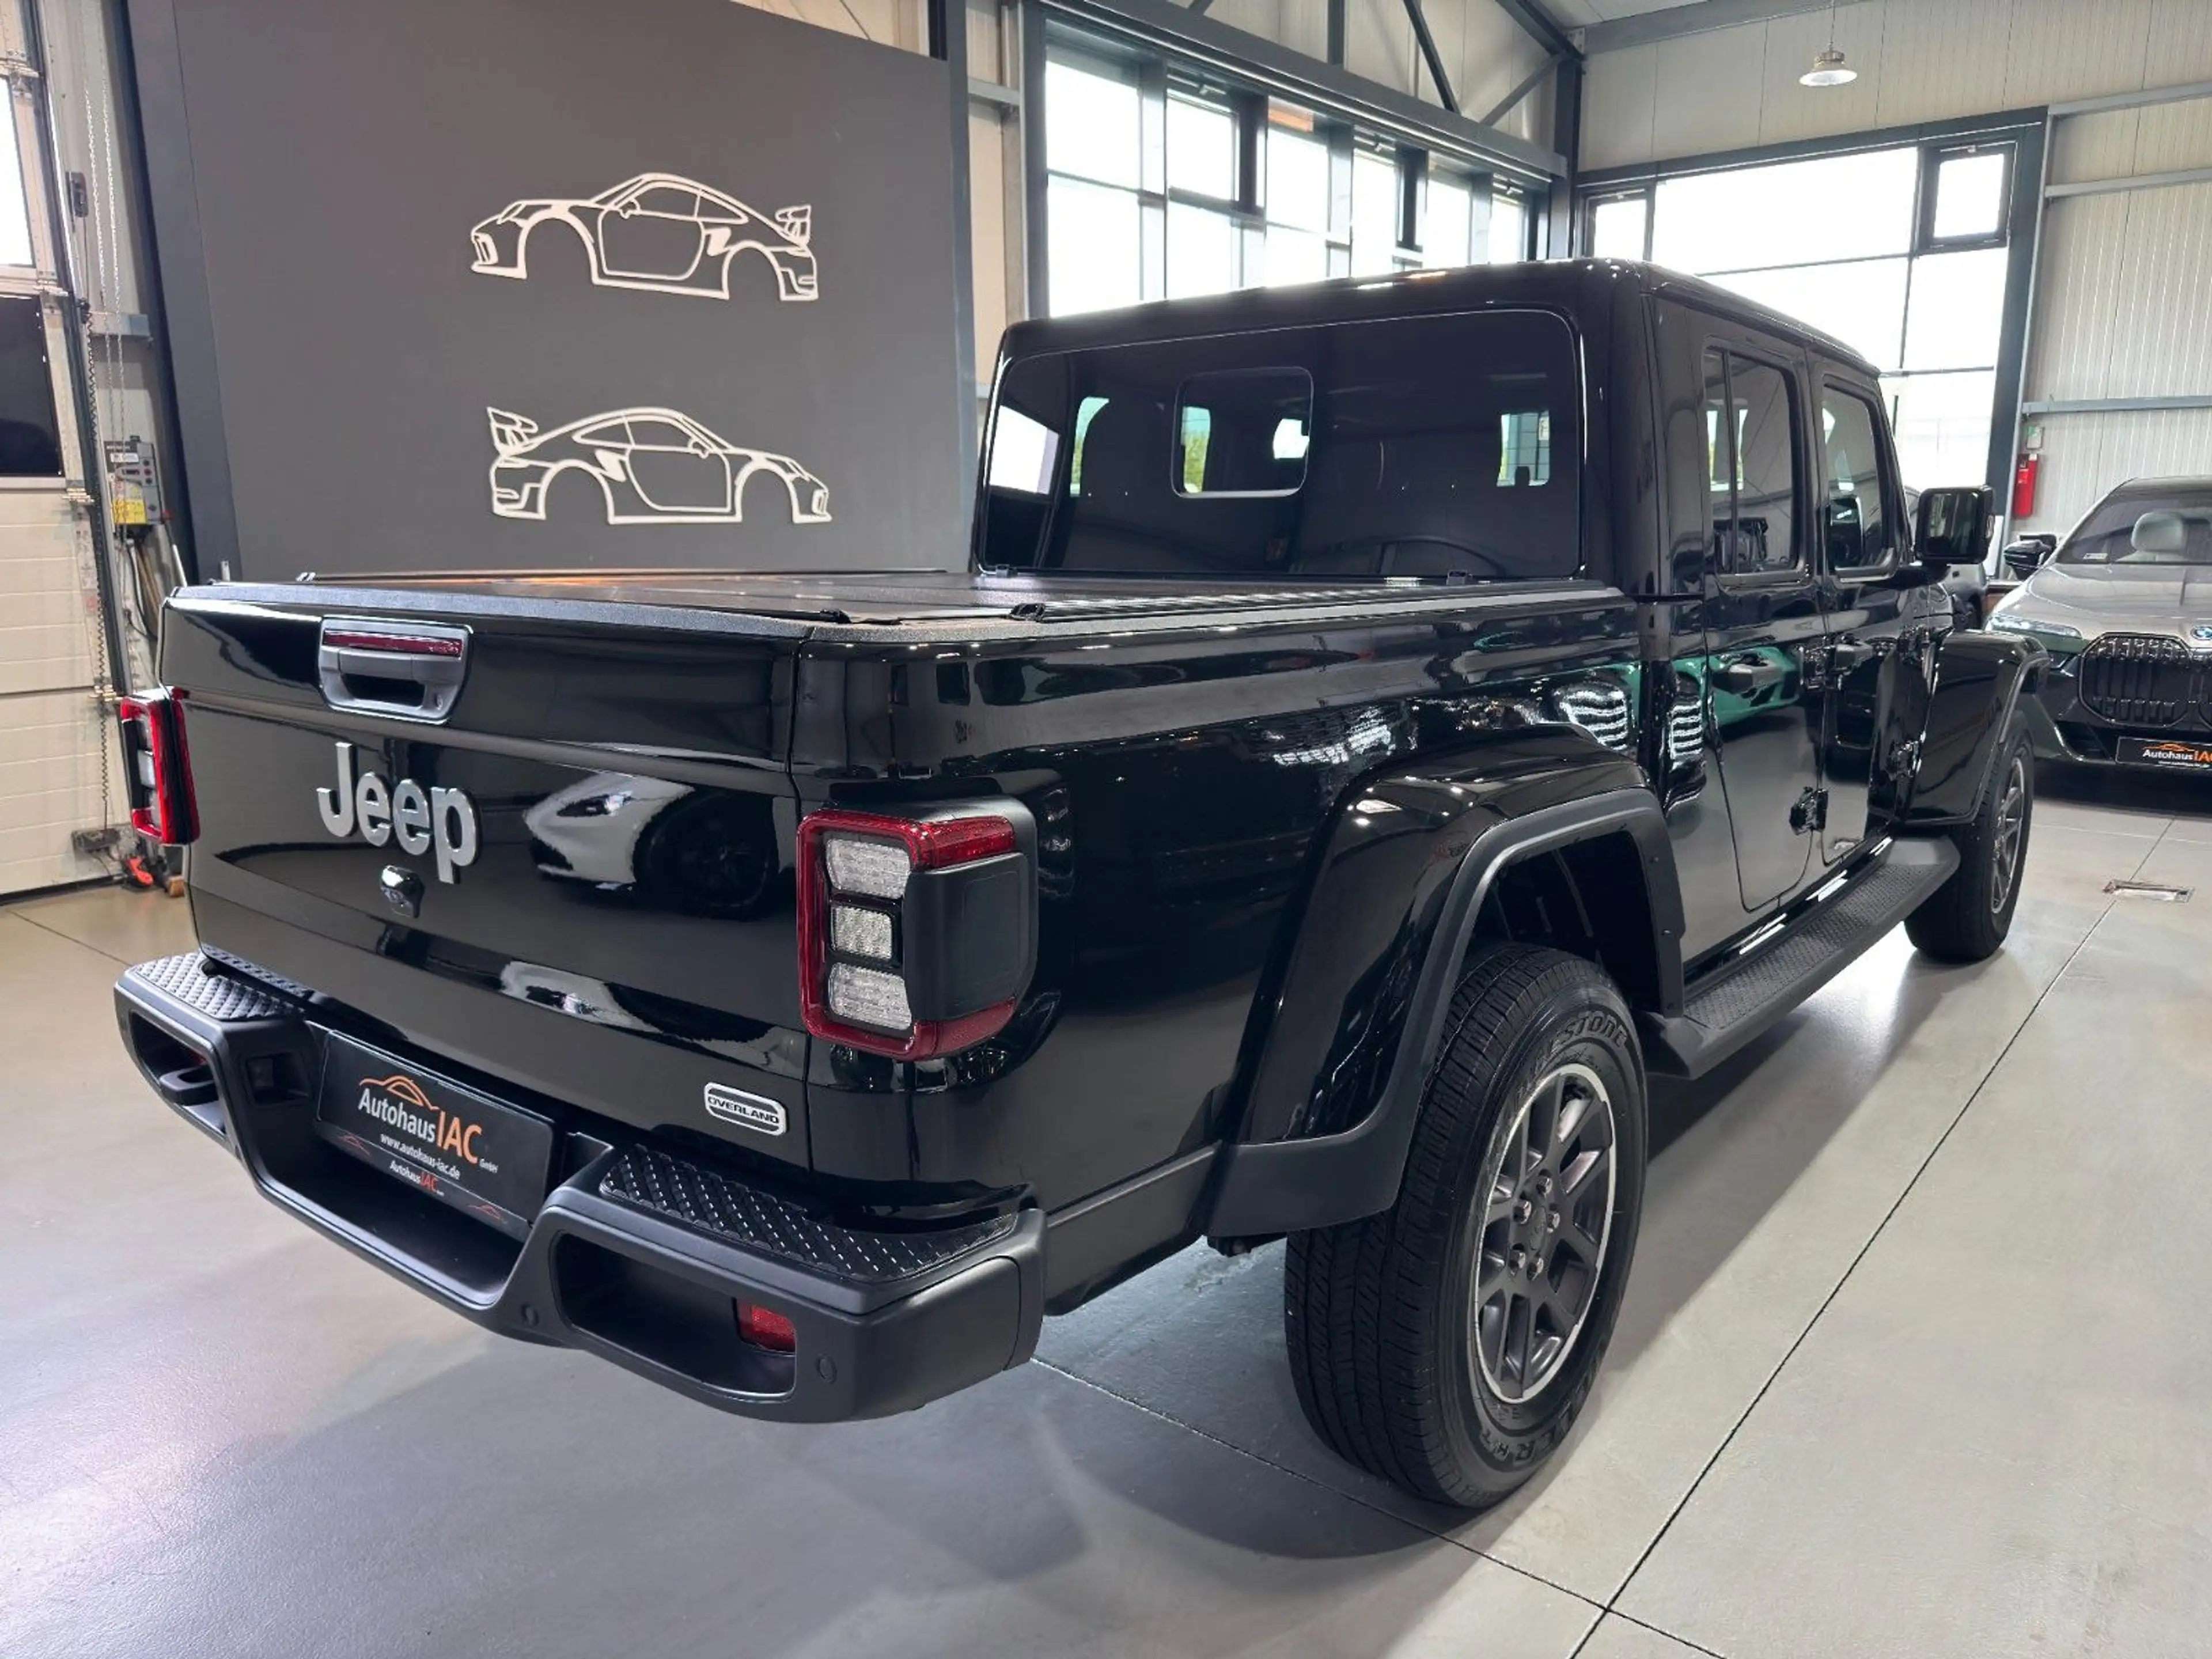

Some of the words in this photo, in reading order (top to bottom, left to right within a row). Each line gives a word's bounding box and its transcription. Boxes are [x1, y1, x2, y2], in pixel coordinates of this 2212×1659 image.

[316, 741, 479, 884] Jeep
[707, 1095, 780, 1124] OVERLAND
[380, 1132, 461, 1180] www.autohaus-iac.de
